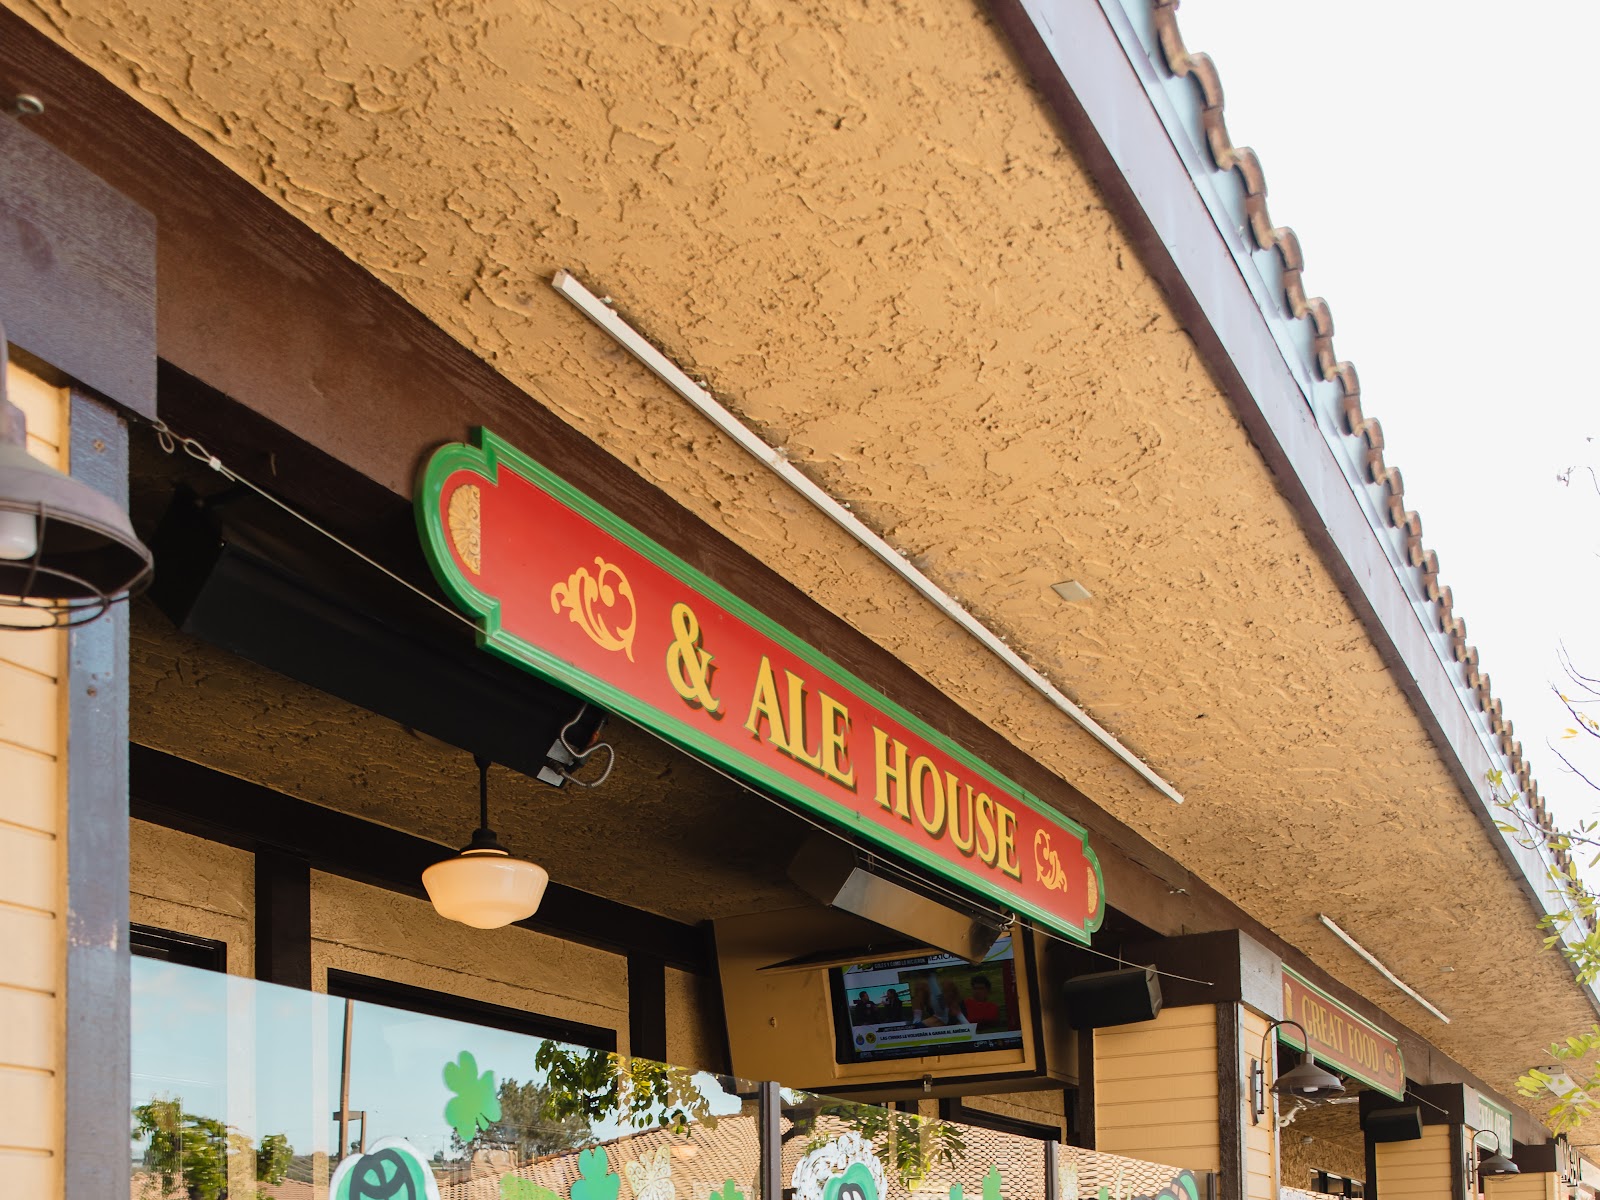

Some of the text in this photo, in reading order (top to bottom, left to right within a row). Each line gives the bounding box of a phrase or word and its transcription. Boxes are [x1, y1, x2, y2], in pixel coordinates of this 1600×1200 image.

[664, 600, 1024, 882] & ALE HOUSE
[1301, 994, 1379, 1073] GREAT FOOD
